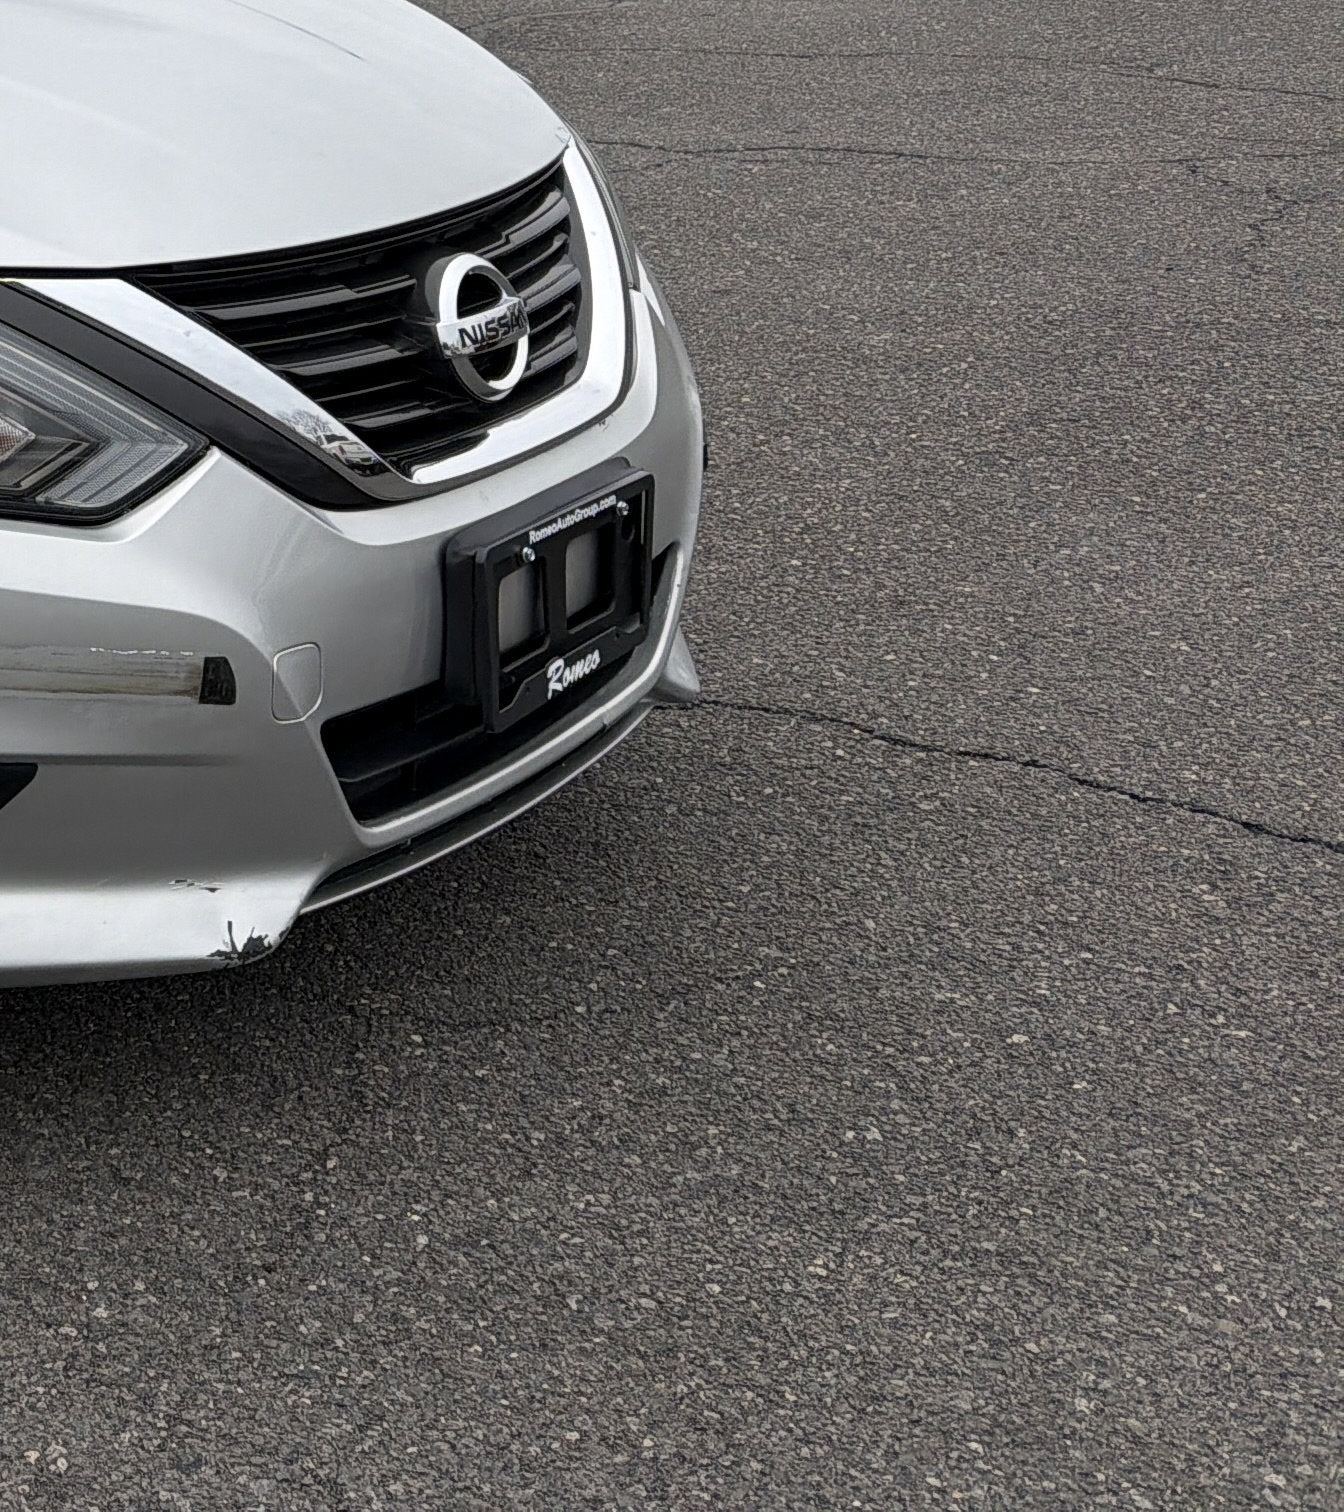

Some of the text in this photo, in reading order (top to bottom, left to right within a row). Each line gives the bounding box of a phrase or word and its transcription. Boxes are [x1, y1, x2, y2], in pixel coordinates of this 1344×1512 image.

[458, 302, 523, 349] NISSAN
[528, 493, 617, 546] RomeoAutoGroup.com
[546, 648, 601, 701] Romeo
